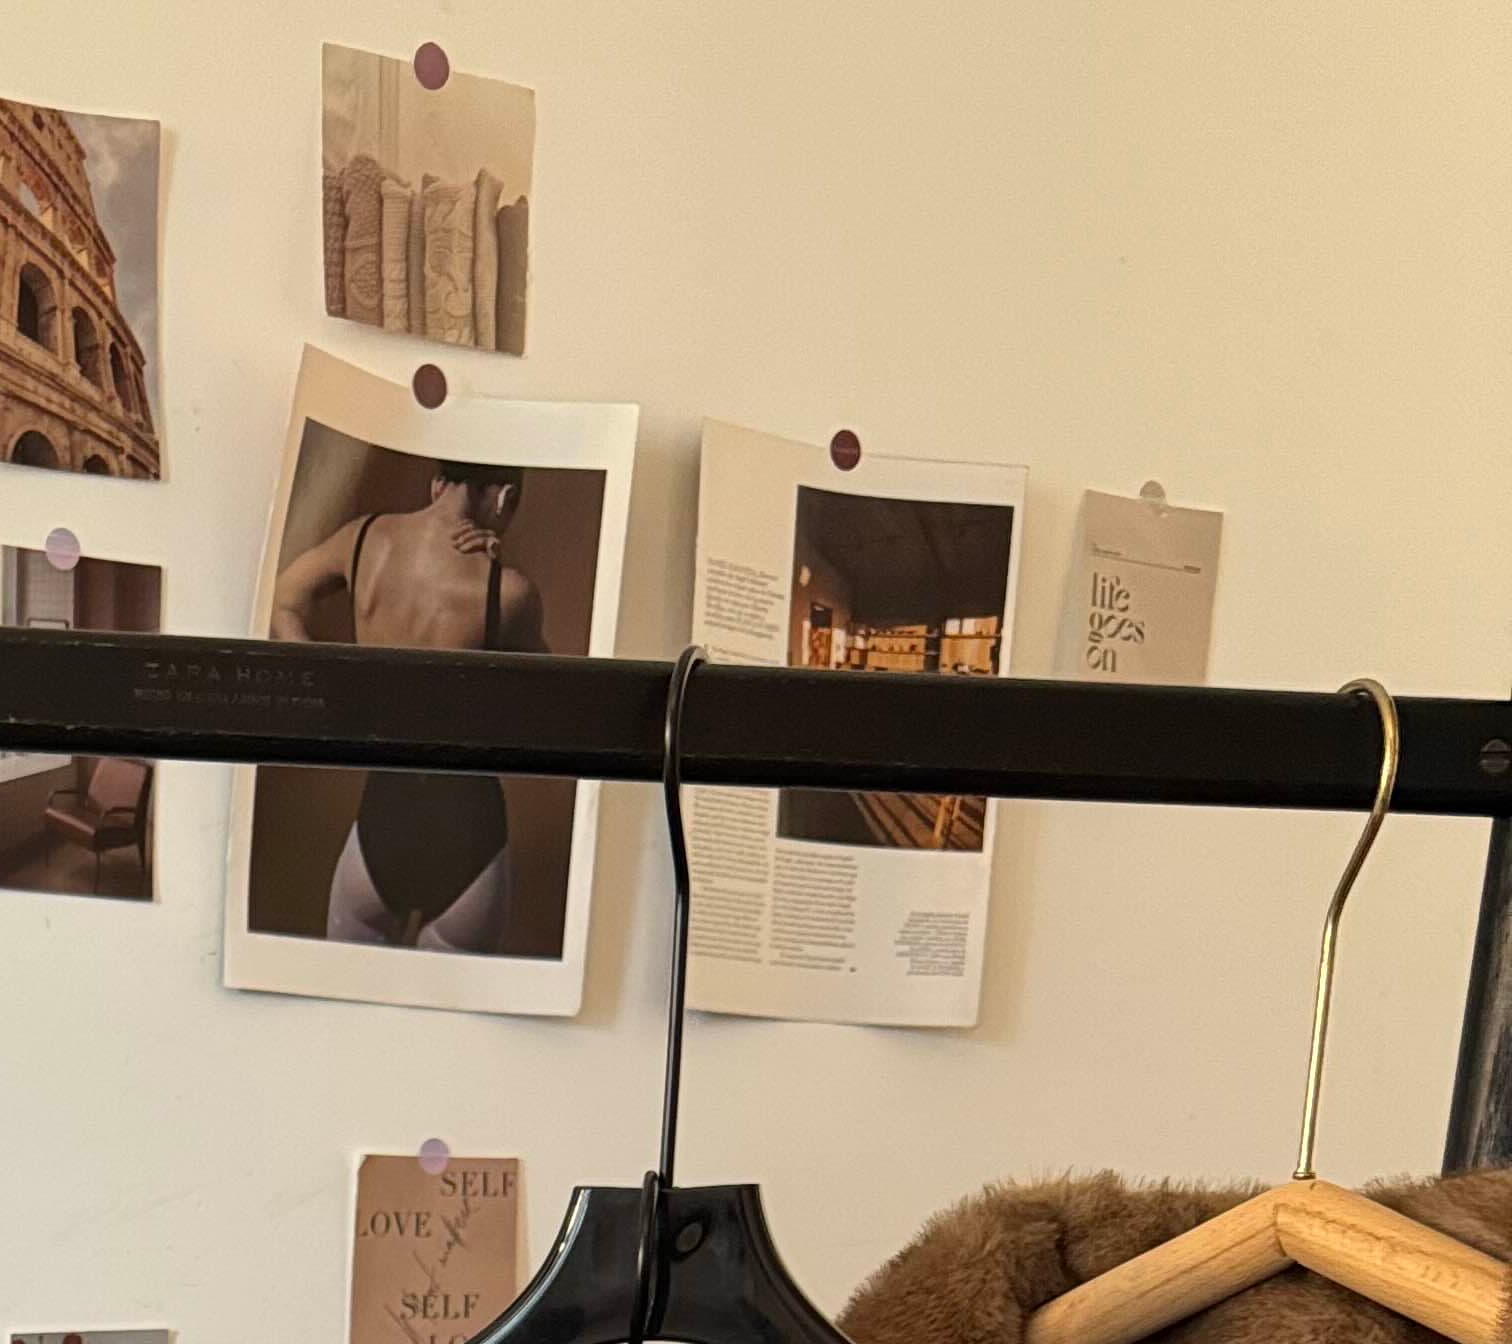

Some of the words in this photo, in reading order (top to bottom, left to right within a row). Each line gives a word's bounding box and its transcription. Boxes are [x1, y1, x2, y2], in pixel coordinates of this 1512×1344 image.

[1091, 571, 1130, 612] life
[440, 1171, 517, 1197] SELF
[360, 1210, 432, 1238] OVE
[399, 1293, 480, 1321] SELF
